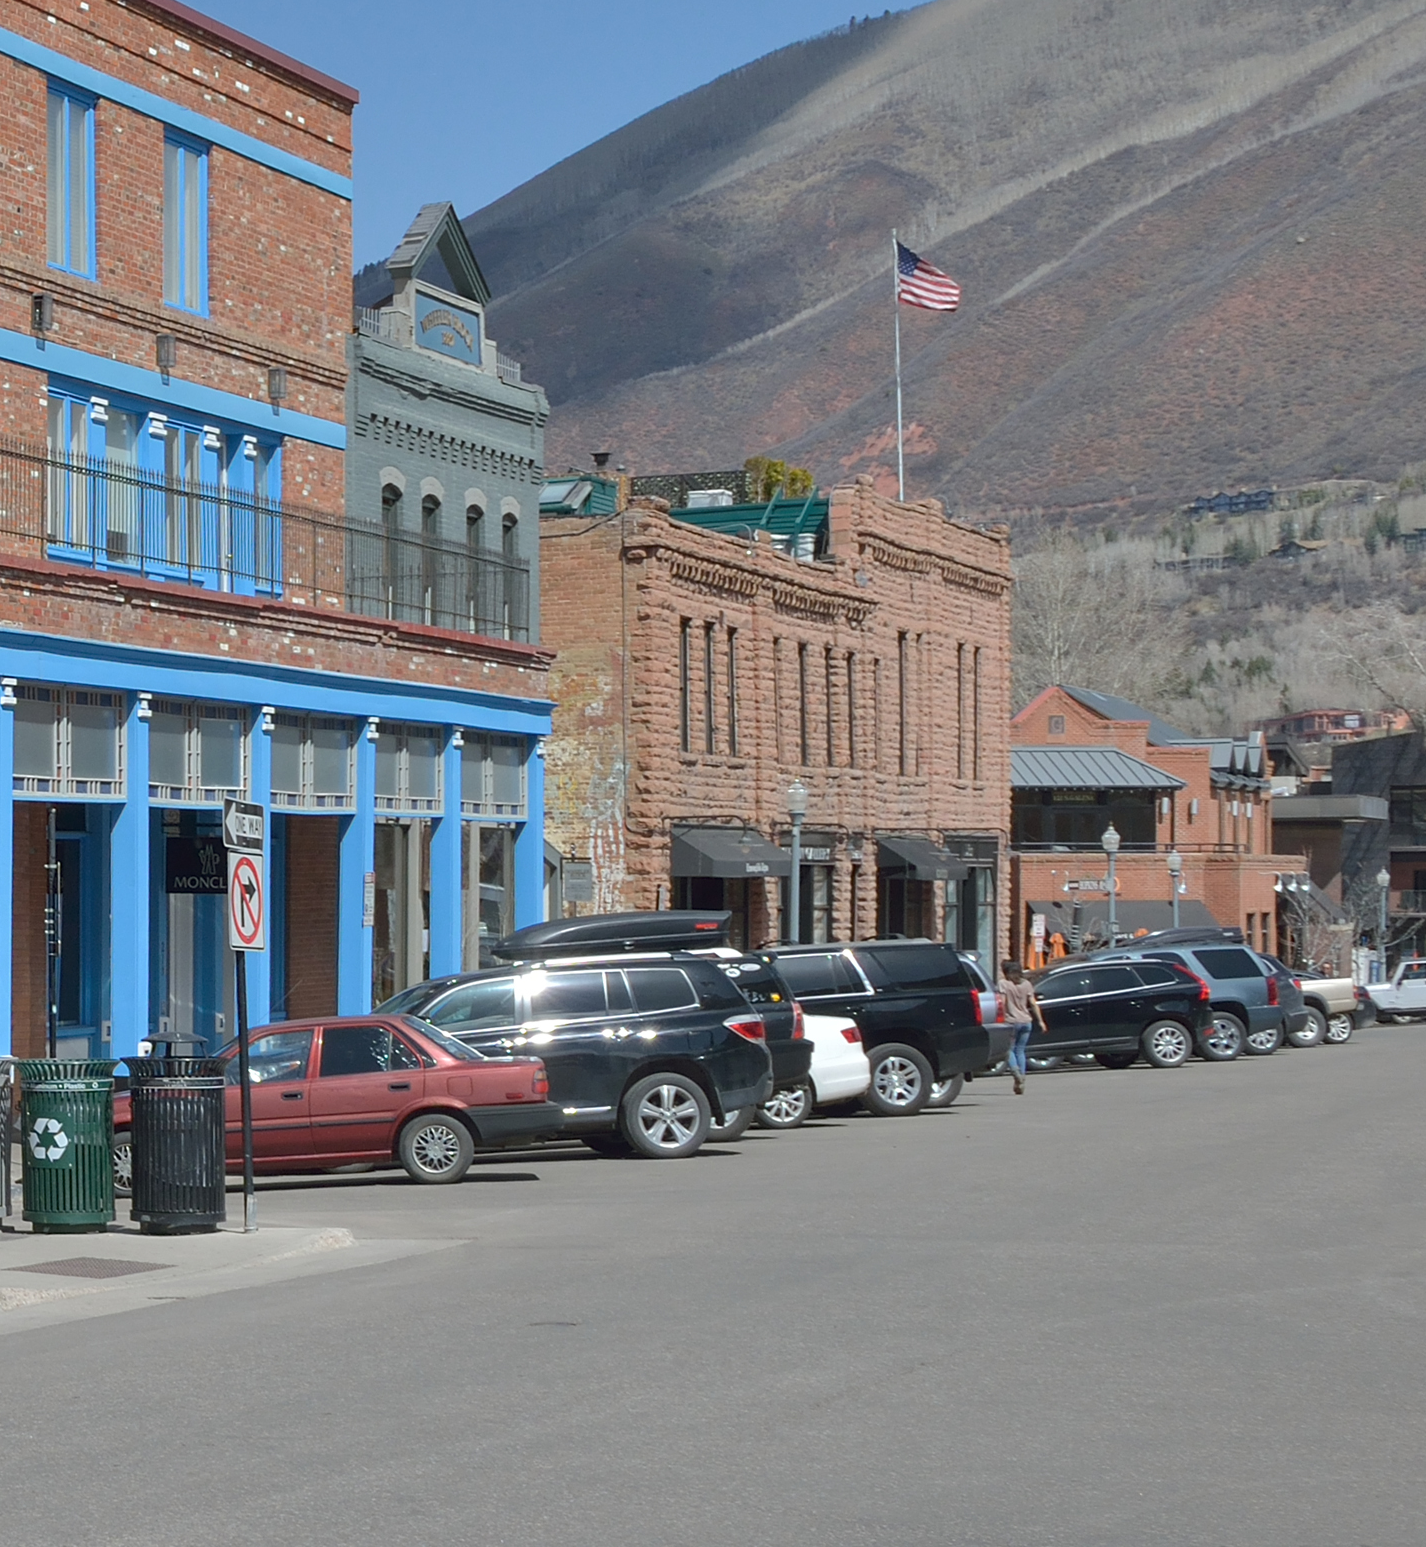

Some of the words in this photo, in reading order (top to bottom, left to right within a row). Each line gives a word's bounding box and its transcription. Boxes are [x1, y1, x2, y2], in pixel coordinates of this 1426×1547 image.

[235, 814, 248, 834] ONE
[249, 817, 262, 838] WAY
[173, 876, 227, 889] MONCL
[63, 1082, 87, 1090] Plastic
